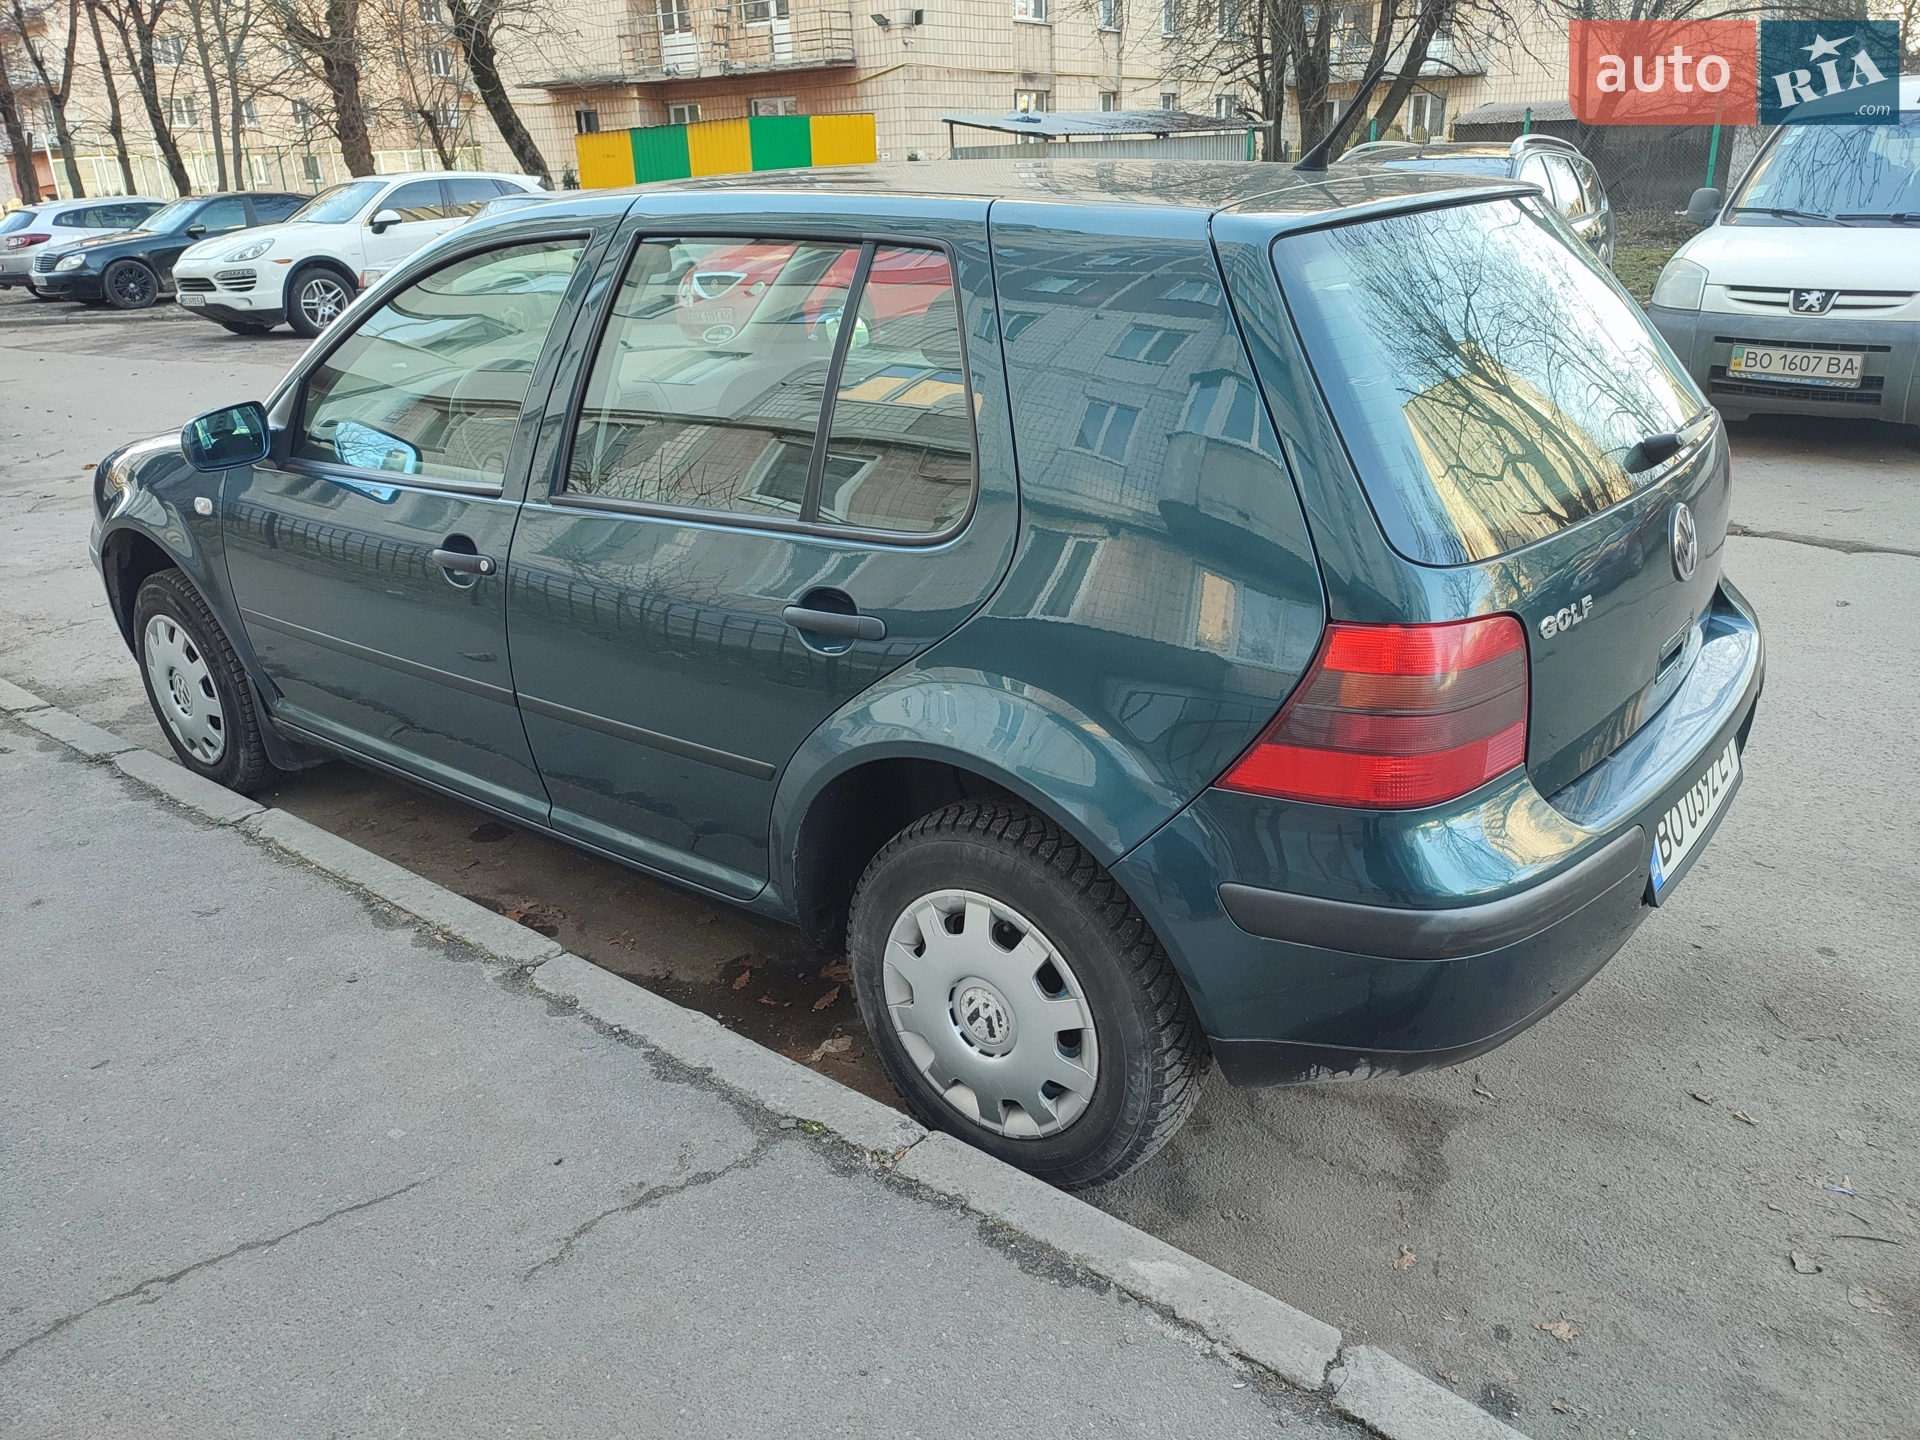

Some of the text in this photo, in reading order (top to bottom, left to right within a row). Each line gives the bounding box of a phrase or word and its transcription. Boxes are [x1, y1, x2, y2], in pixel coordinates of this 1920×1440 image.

[1744, 351, 1855, 375] BO 1607 BA
[1769, 375, 1812, 384] MICHELIN
[1539, 594, 1594, 639] GOLF
[1657, 802, 1684, 868] BO
